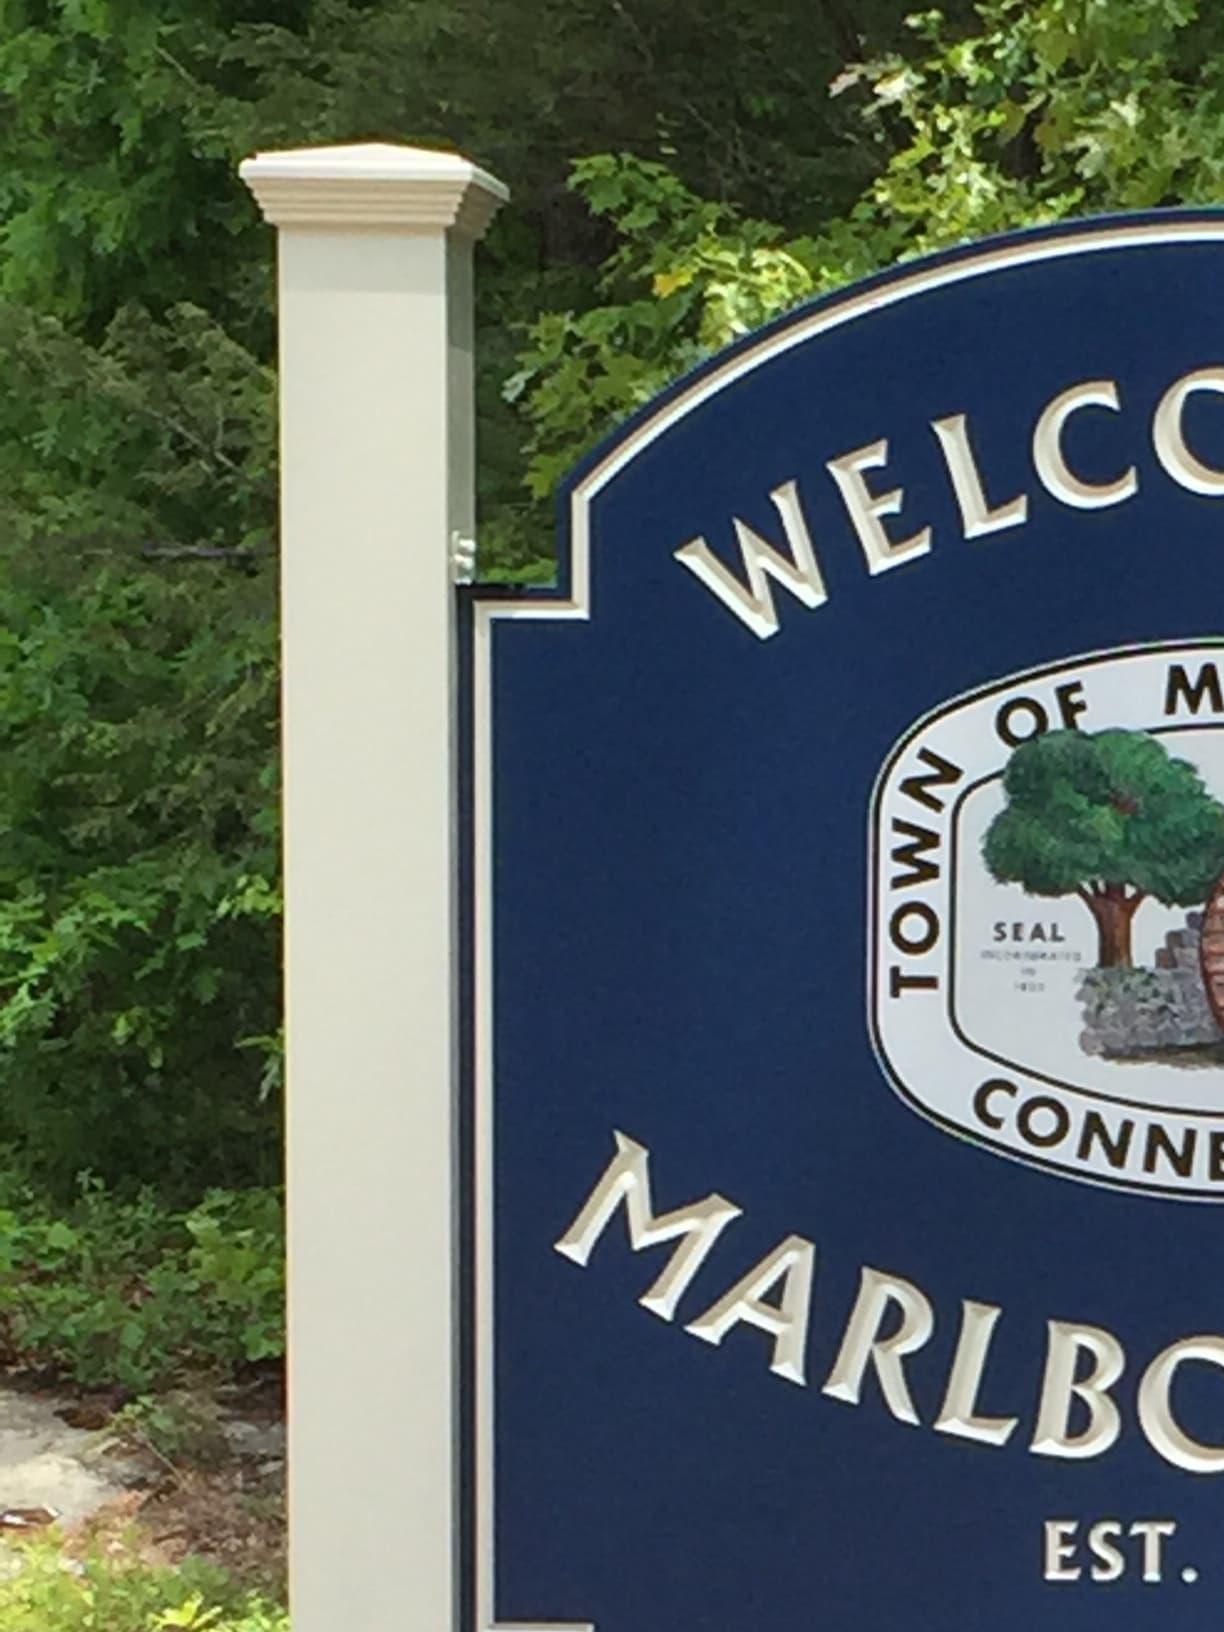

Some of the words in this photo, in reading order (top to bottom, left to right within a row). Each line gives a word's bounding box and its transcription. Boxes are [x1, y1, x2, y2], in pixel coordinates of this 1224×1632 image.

[889, 748, 963, 999] TOWN
[995, 681, 1087, 749] OF
[993, 922, 1065, 942] SEAL
[1044, 1521, 1198, 1583] EST.
